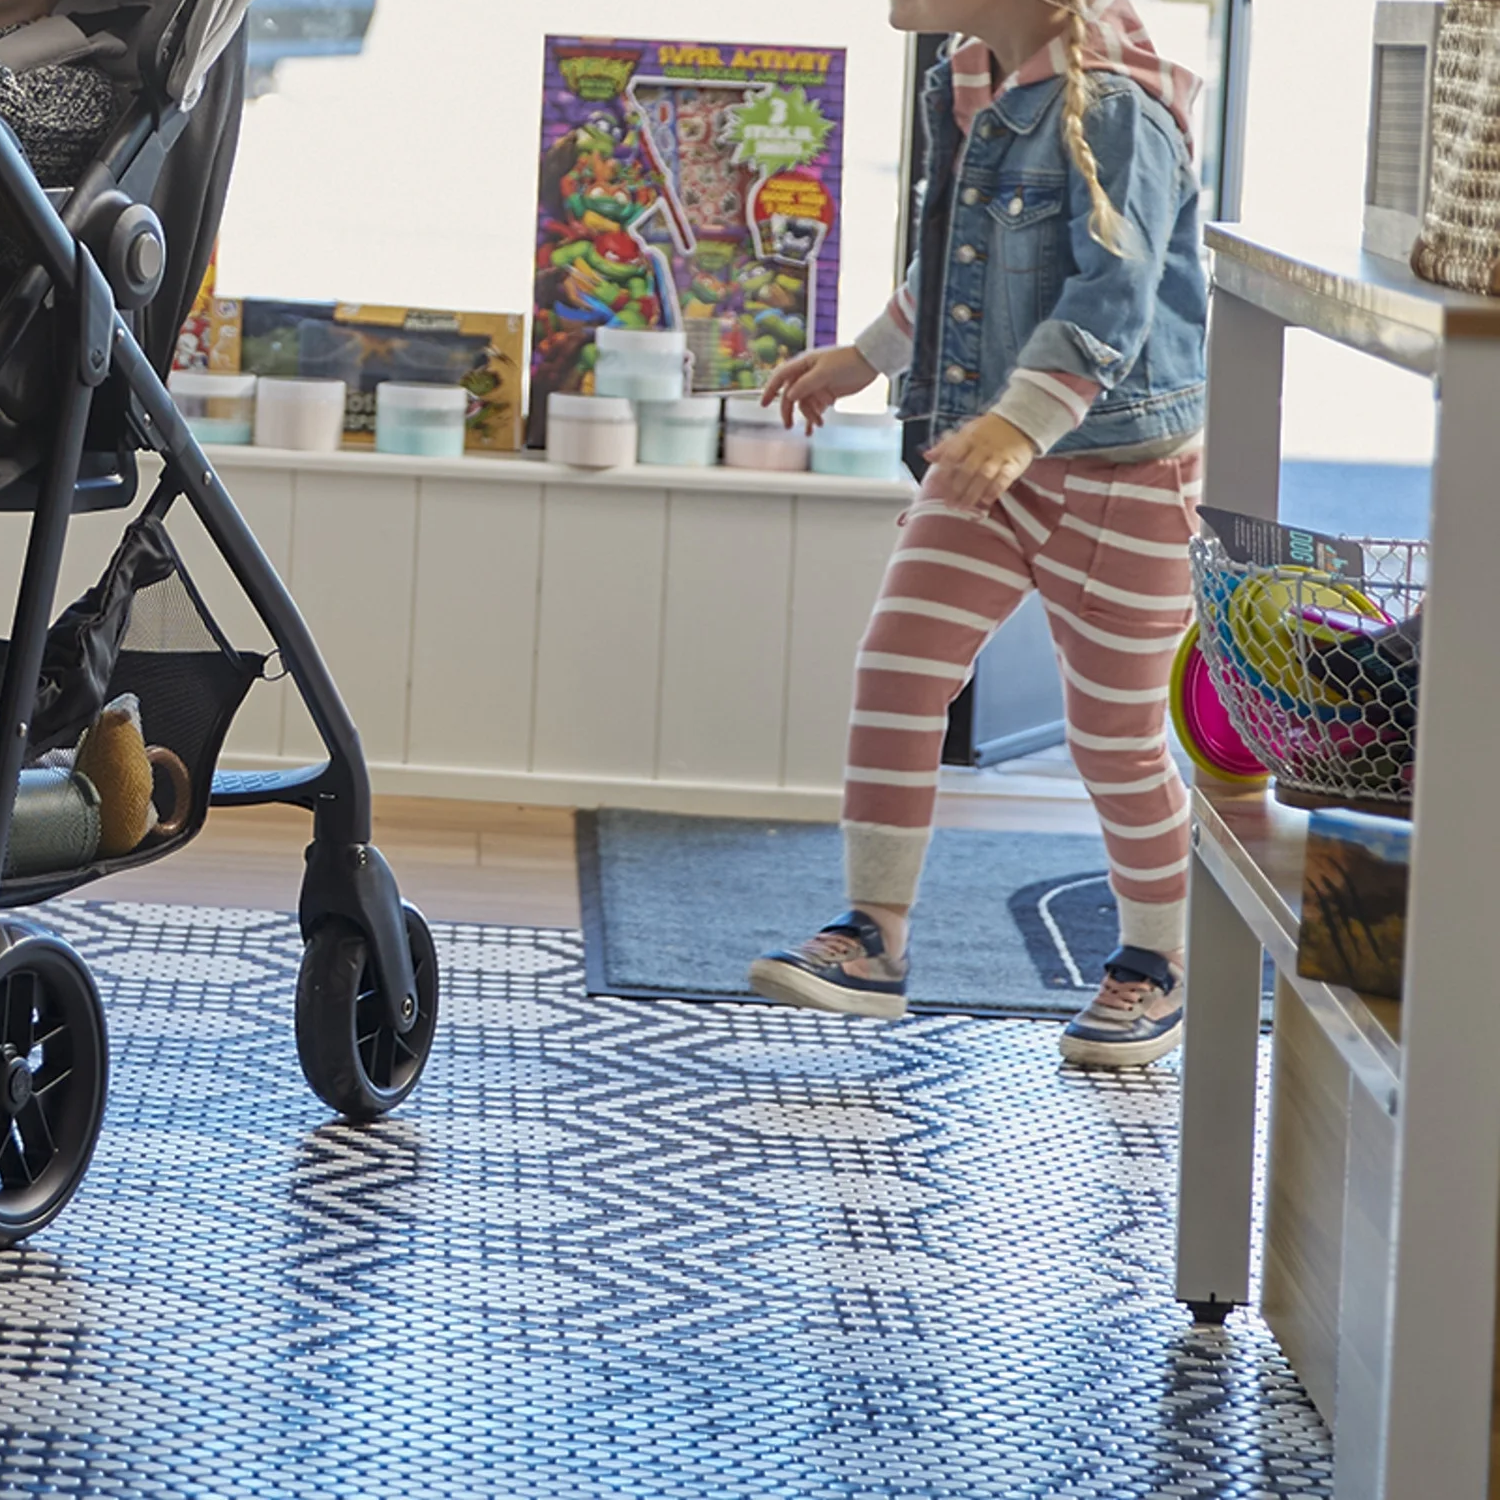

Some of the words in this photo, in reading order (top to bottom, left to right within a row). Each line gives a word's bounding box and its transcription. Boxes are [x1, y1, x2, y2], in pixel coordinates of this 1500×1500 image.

[658, 45, 726, 67] SUPER
[730, 48, 831, 72] ACTIVITY
[1289, 529, 1315, 563] DOG
